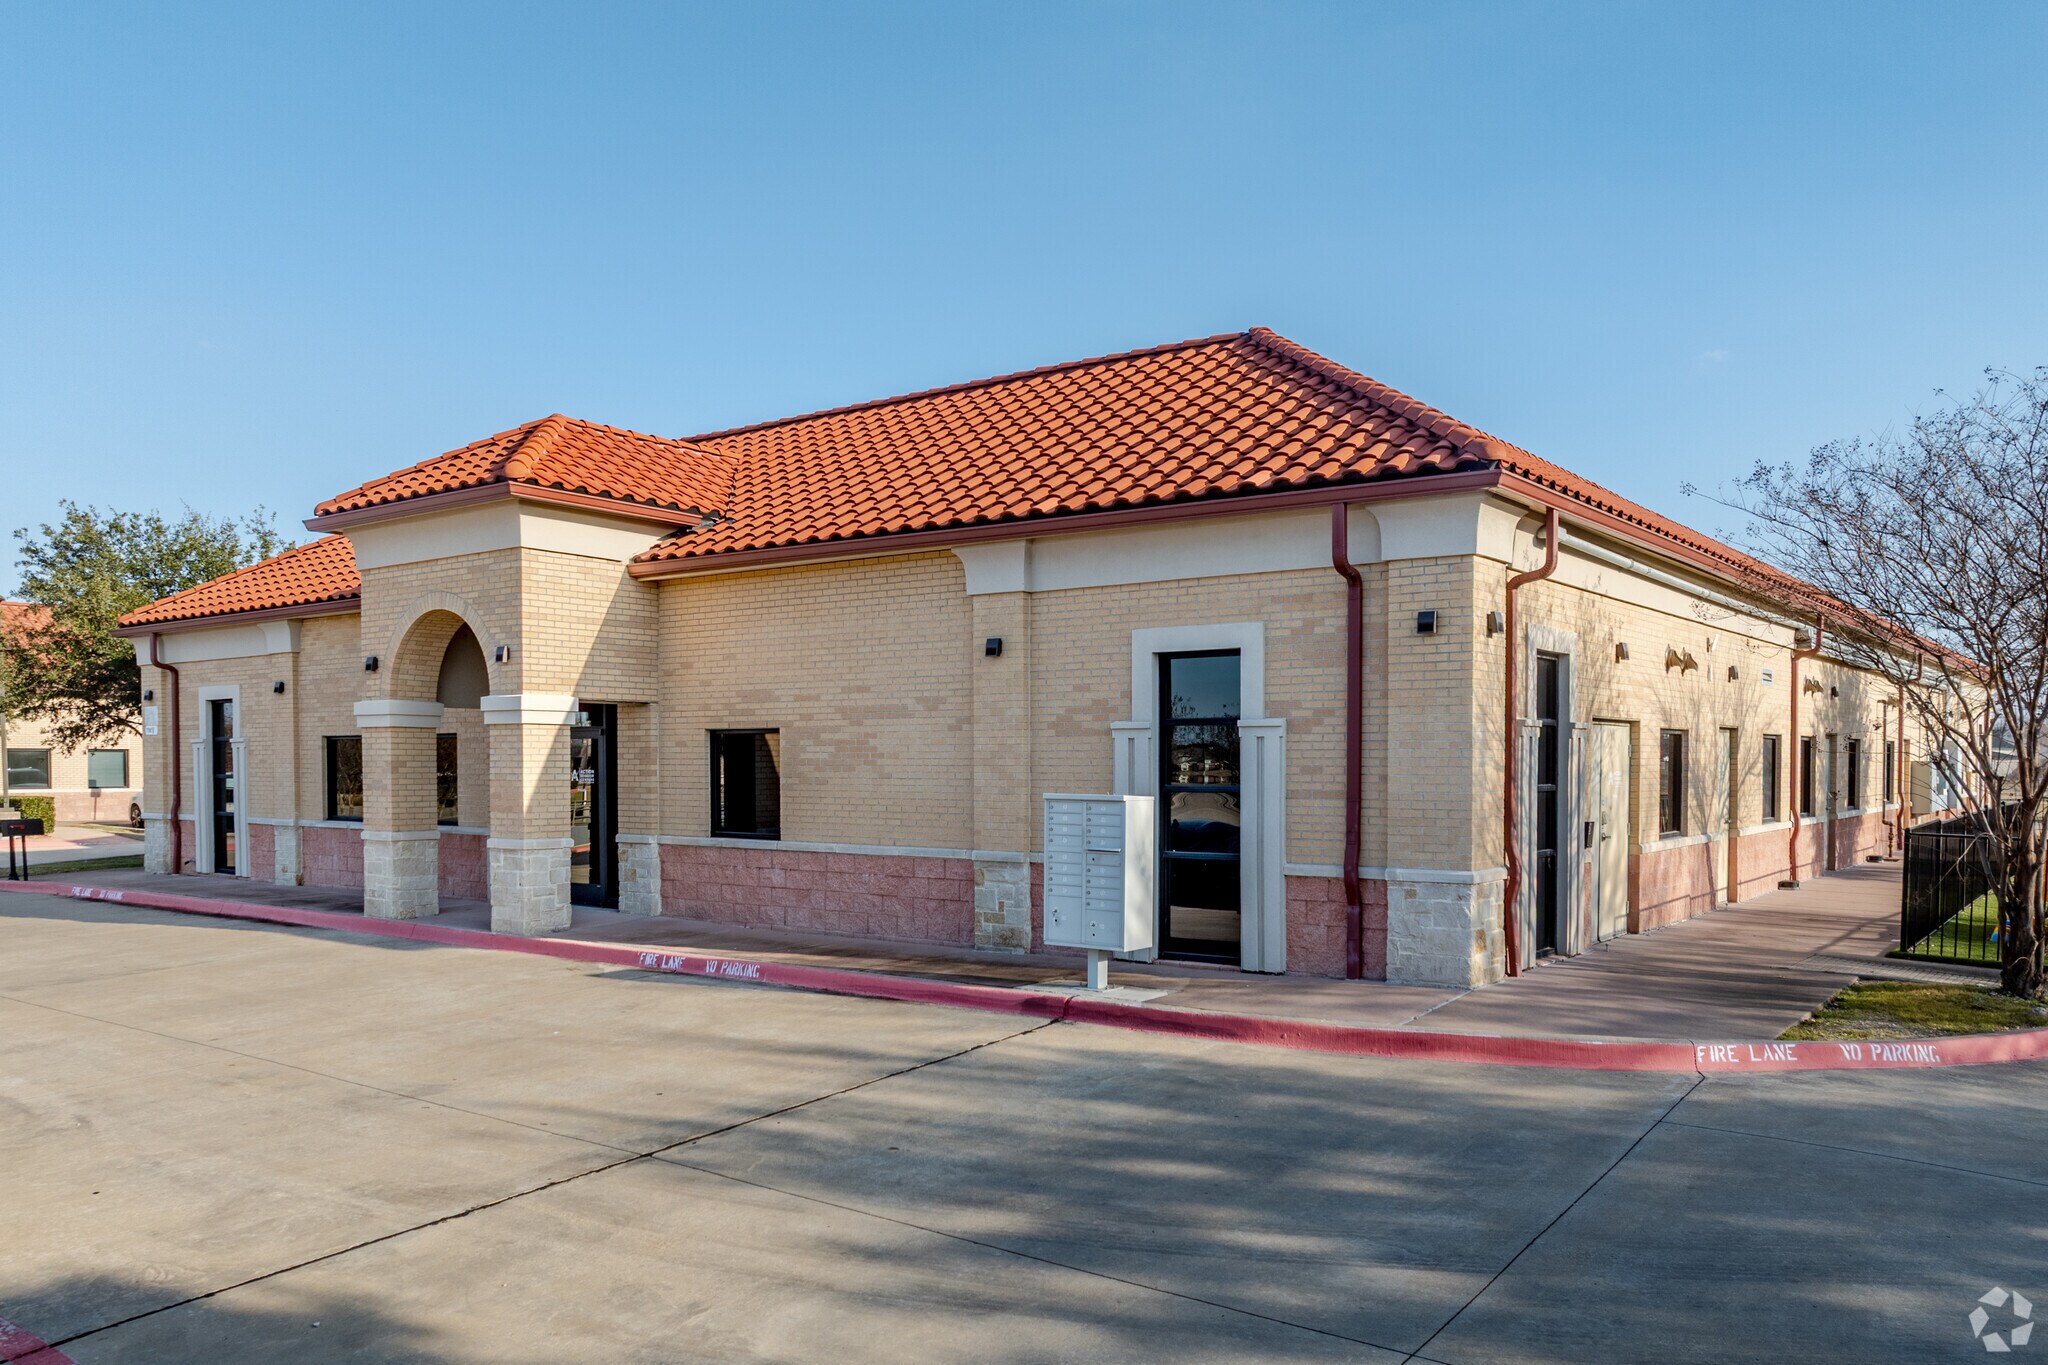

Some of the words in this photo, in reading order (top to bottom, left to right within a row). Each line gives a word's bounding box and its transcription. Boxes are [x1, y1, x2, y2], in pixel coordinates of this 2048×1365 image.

[639, 952, 660, 967] FIRE
[661, 955, 686, 970] LANE
[720, 961, 761, 978] PARKING
[1697, 1044, 1740, 1063] FIRE
[1750, 1043, 1798, 1062] LANE
[1870, 1043, 1940, 1063] PARKING
